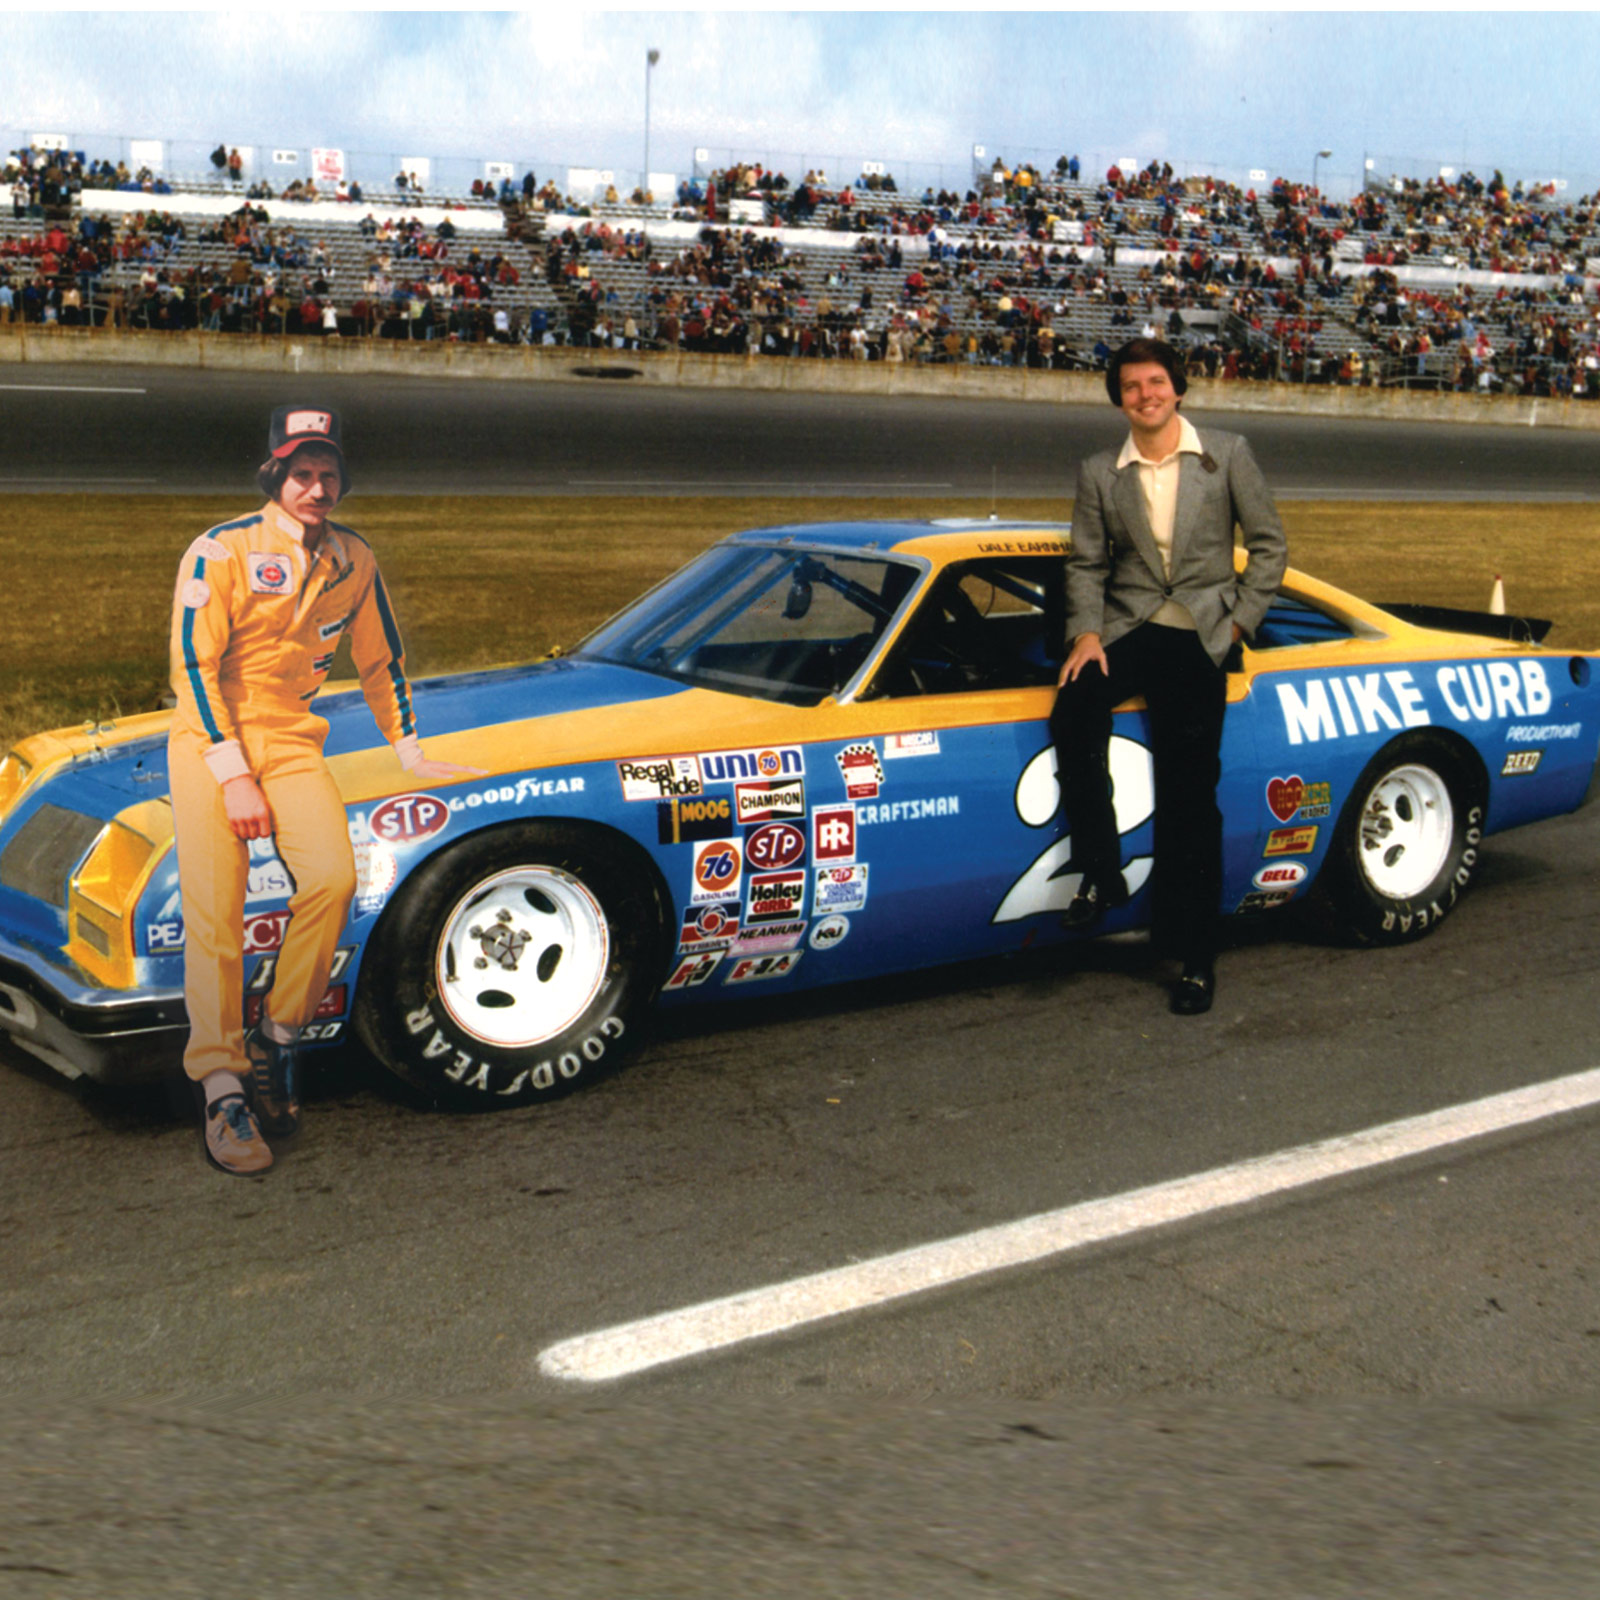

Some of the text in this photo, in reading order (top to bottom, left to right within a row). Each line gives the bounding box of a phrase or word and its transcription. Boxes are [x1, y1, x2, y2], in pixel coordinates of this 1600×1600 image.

[1016, 541, 1071, 553] EARNH
[1276, 659, 1552, 745] MIKE CURB
[619, 759, 675, 783] Regal
[762, 757, 776, 769] 76
[450, 776, 585, 812] GOODYEAR
[659, 776, 700, 796] Ride
[680, 799, 731, 822] MOOG
[741, 792, 800, 810] CHAMPION
[856, 795, 960, 826] CRAFTSMAN
[379, 797, 437, 838] STP
[754, 827, 796, 860] STP
[702, 850, 734, 880] 76
[1261, 869, 1298, 882] BELL
[693, 890, 737, 902] GASOLINE
[750, 882, 803, 902] Holley
[405, 1004, 625, 1095] GOODYEAR
